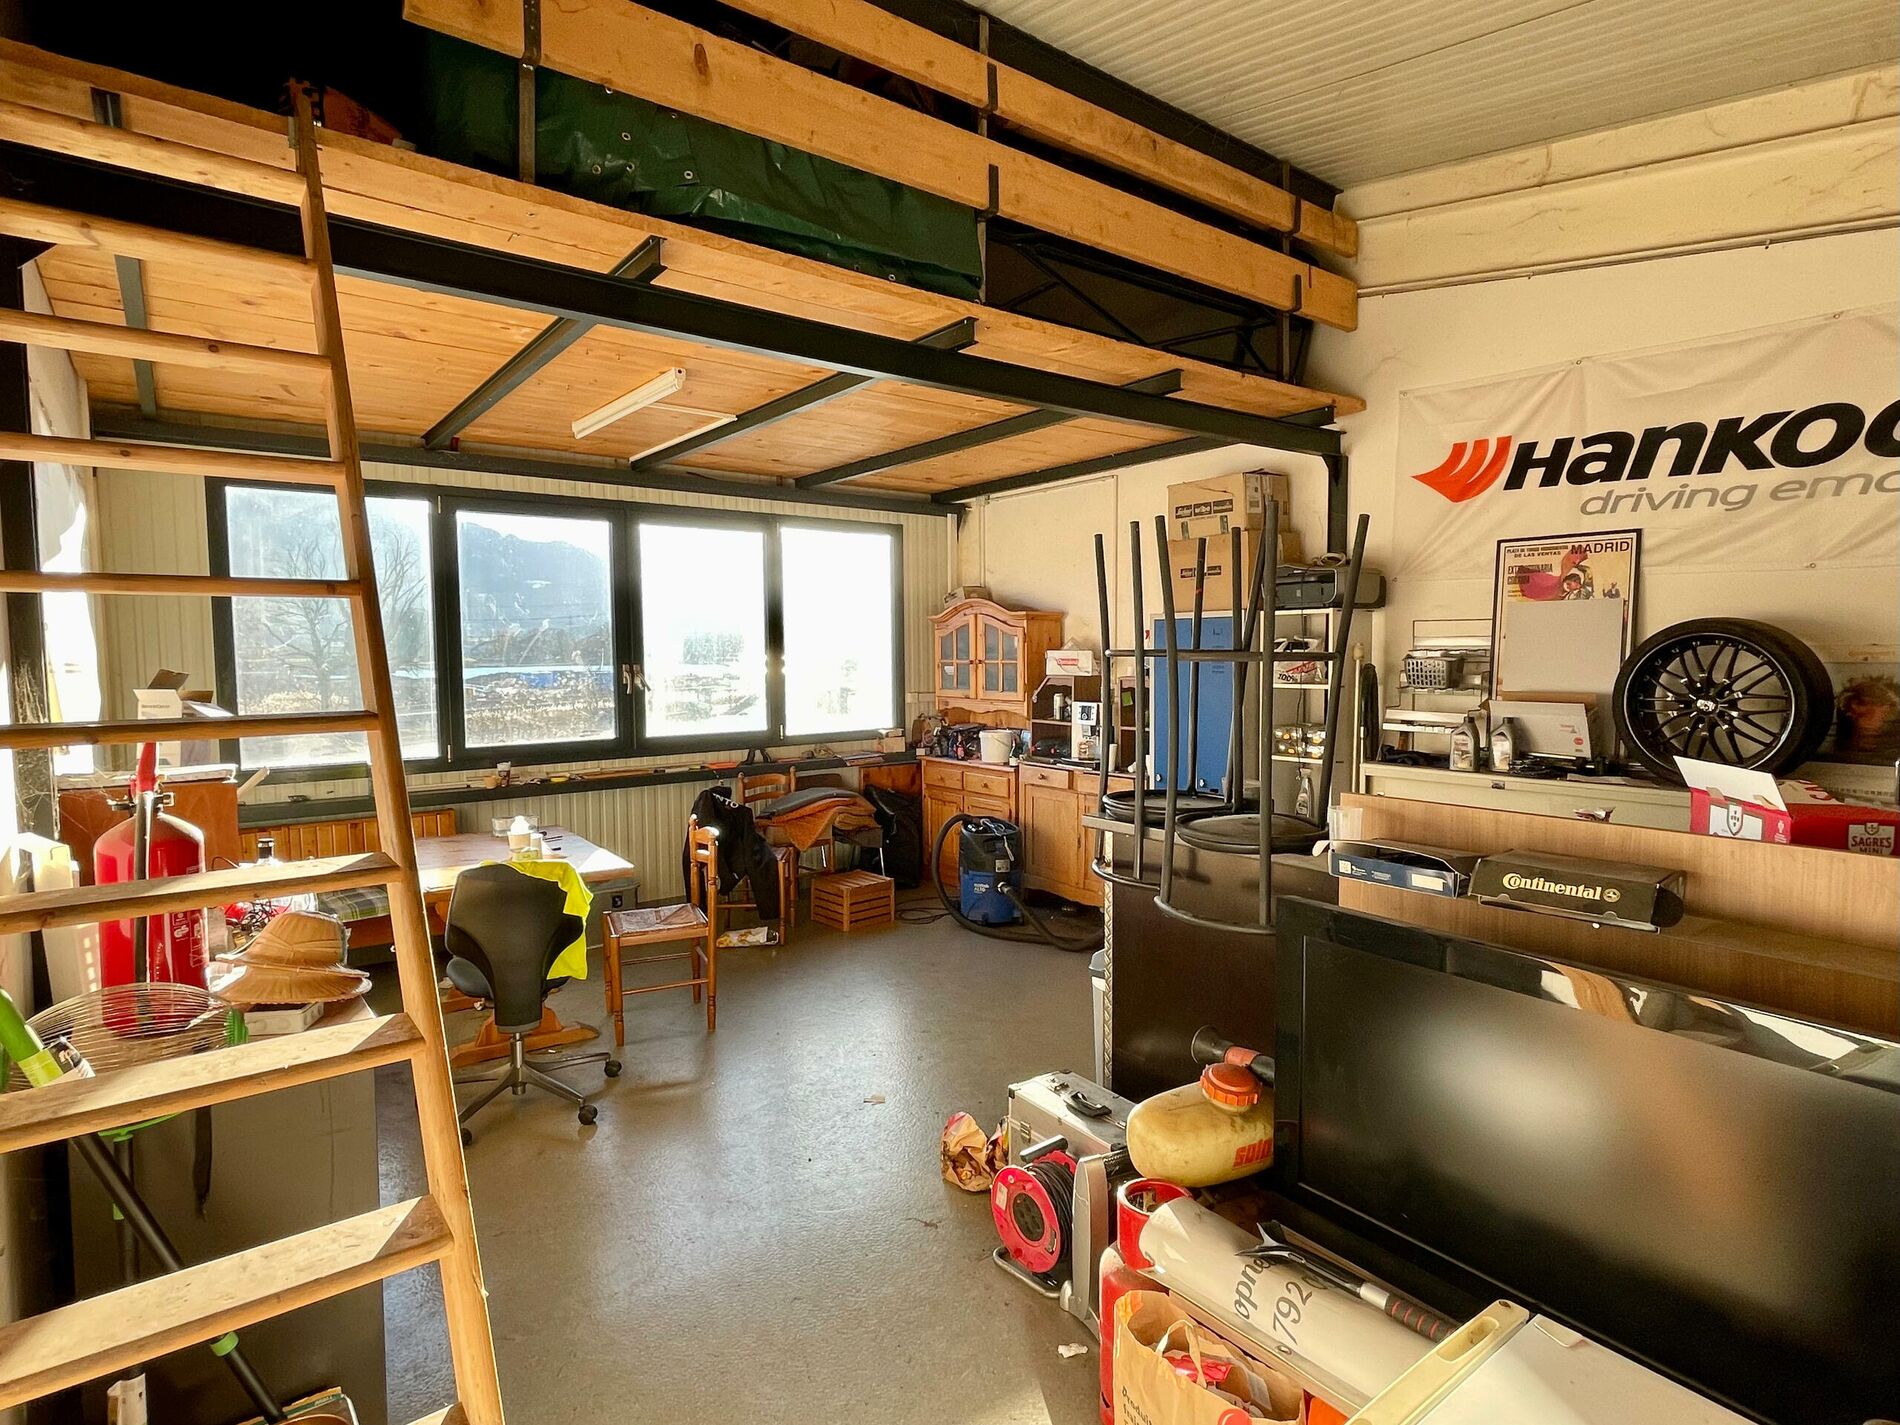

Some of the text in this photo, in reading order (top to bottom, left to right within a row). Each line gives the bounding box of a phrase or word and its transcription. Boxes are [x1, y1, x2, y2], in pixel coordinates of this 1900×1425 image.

[1580, 482, 1757, 516] driving
[1571, 541, 1629, 554] MADRID
[1851, 836, 1892, 849] SAGRES
[1502, 872, 1601, 901] Continental
